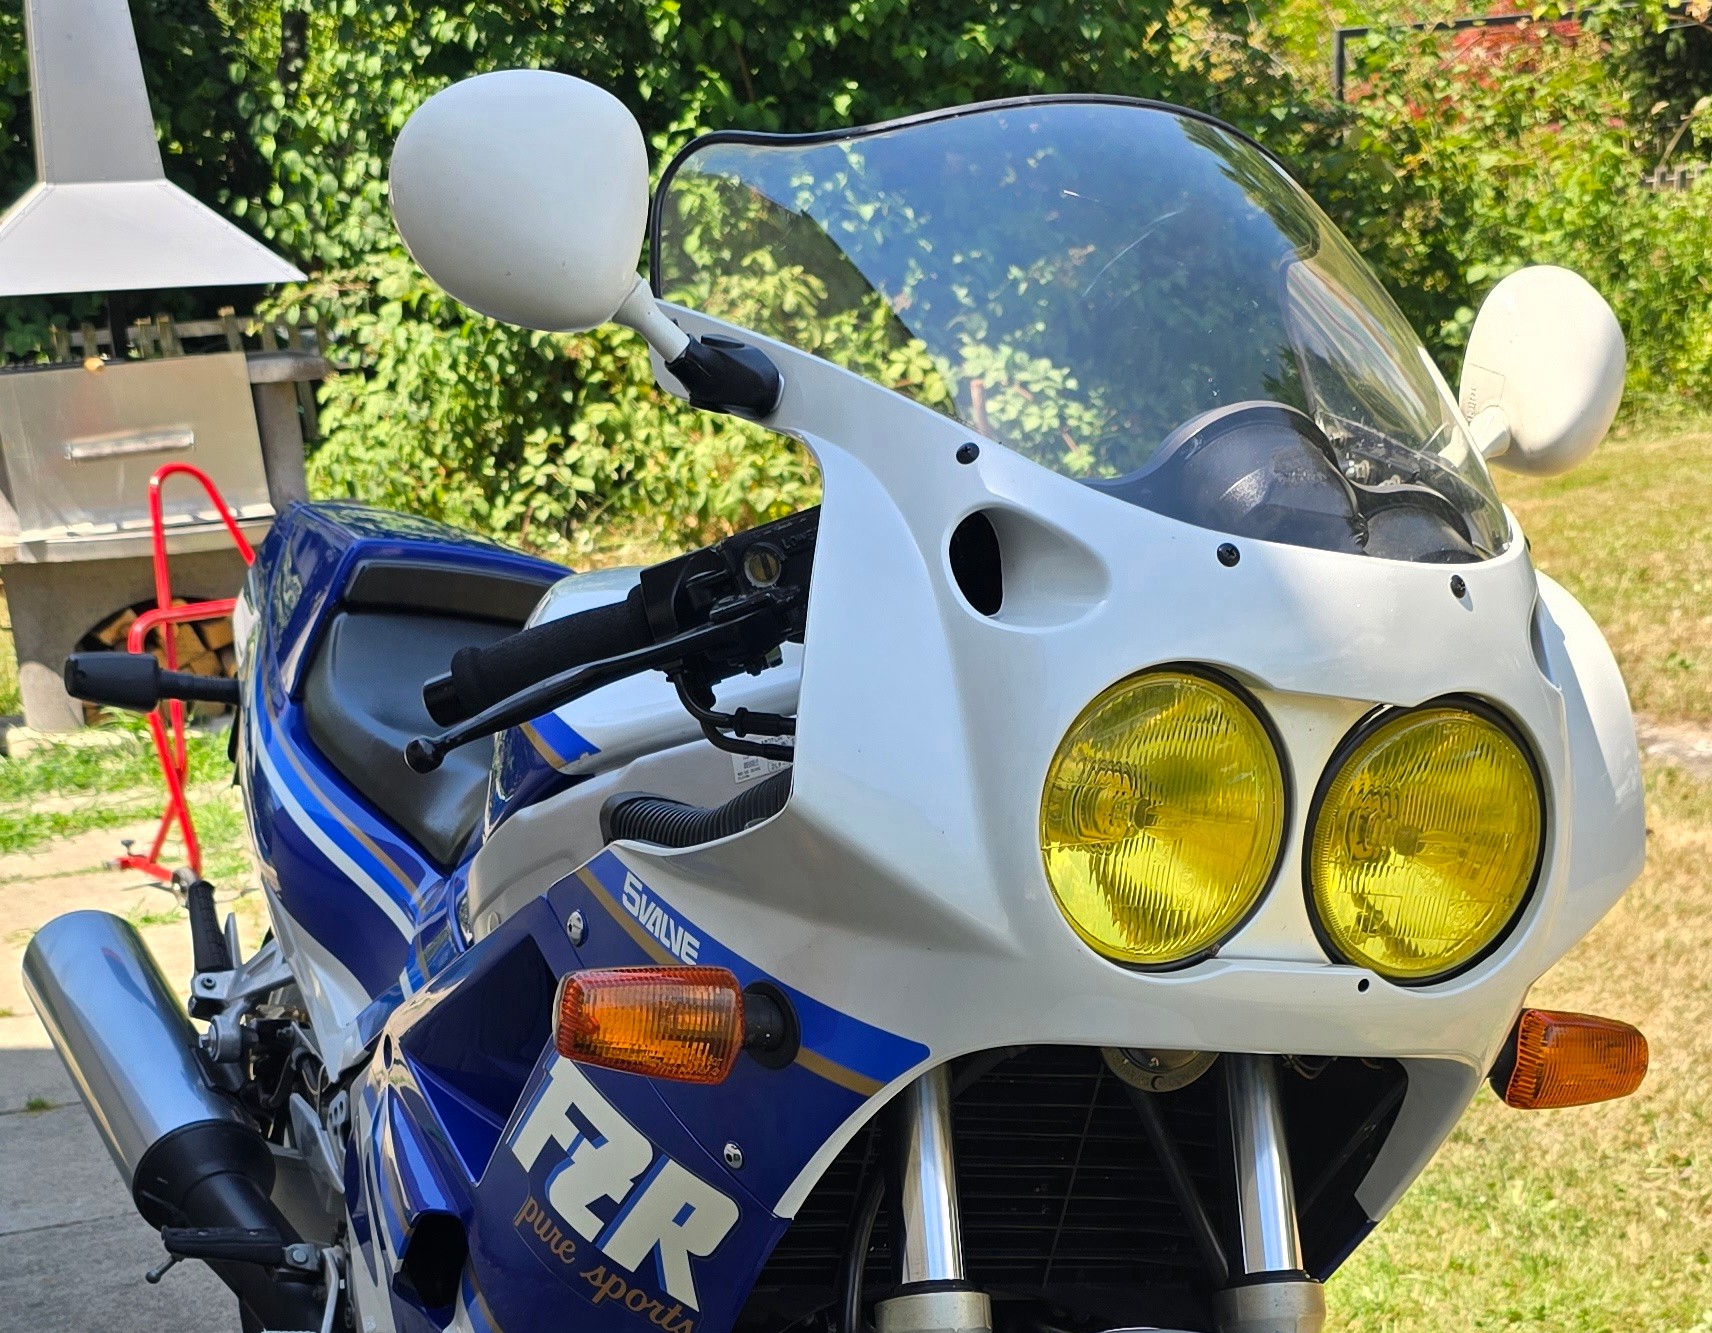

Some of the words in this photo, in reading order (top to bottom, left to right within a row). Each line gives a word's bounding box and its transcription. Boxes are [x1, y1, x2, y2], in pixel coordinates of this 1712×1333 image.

[781, 527, 818, 549] LOWE
[506, 1053, 740, 1313] FZR
[513, 1196, 576, 1264] pure
